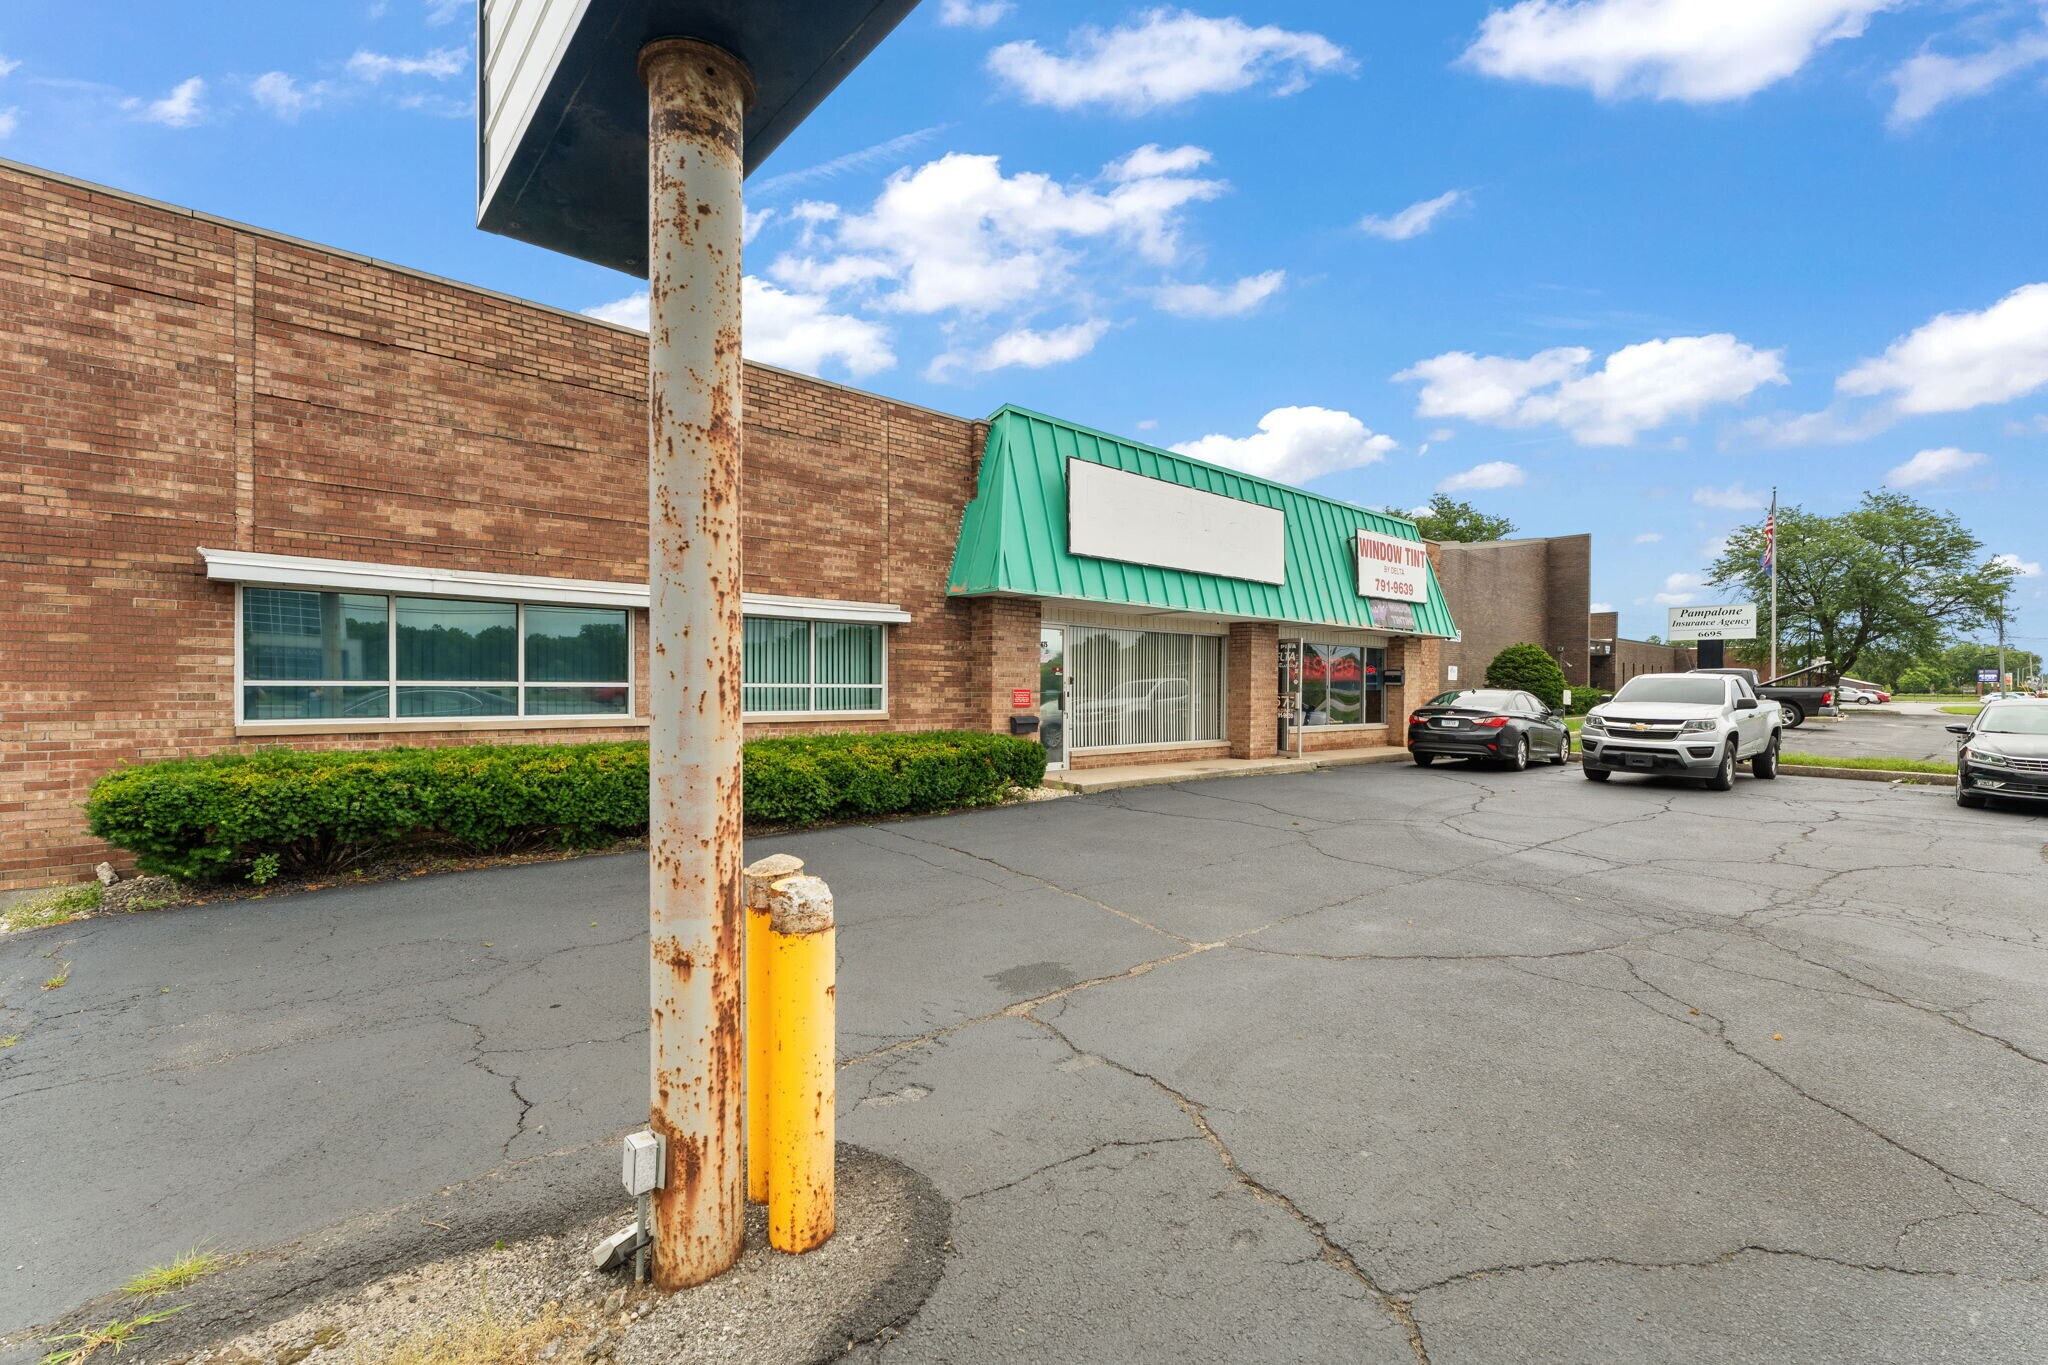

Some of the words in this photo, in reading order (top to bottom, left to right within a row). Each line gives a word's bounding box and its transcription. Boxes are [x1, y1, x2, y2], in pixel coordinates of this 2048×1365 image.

[1359, 538, 1402, 565] WINDOW
[1405, 547, 1426, 568] TINT
[1391, 566, 1405, 575] DELTA
[1375, 578, 1414, 596] 791-9639
[1680, 607, 1743, 619] Pampalone
[1672, 620, 1716, 628] Insurance
[1717, 618, 1752, 626] Agency
[1697, 630, 1722, 638] 6695
